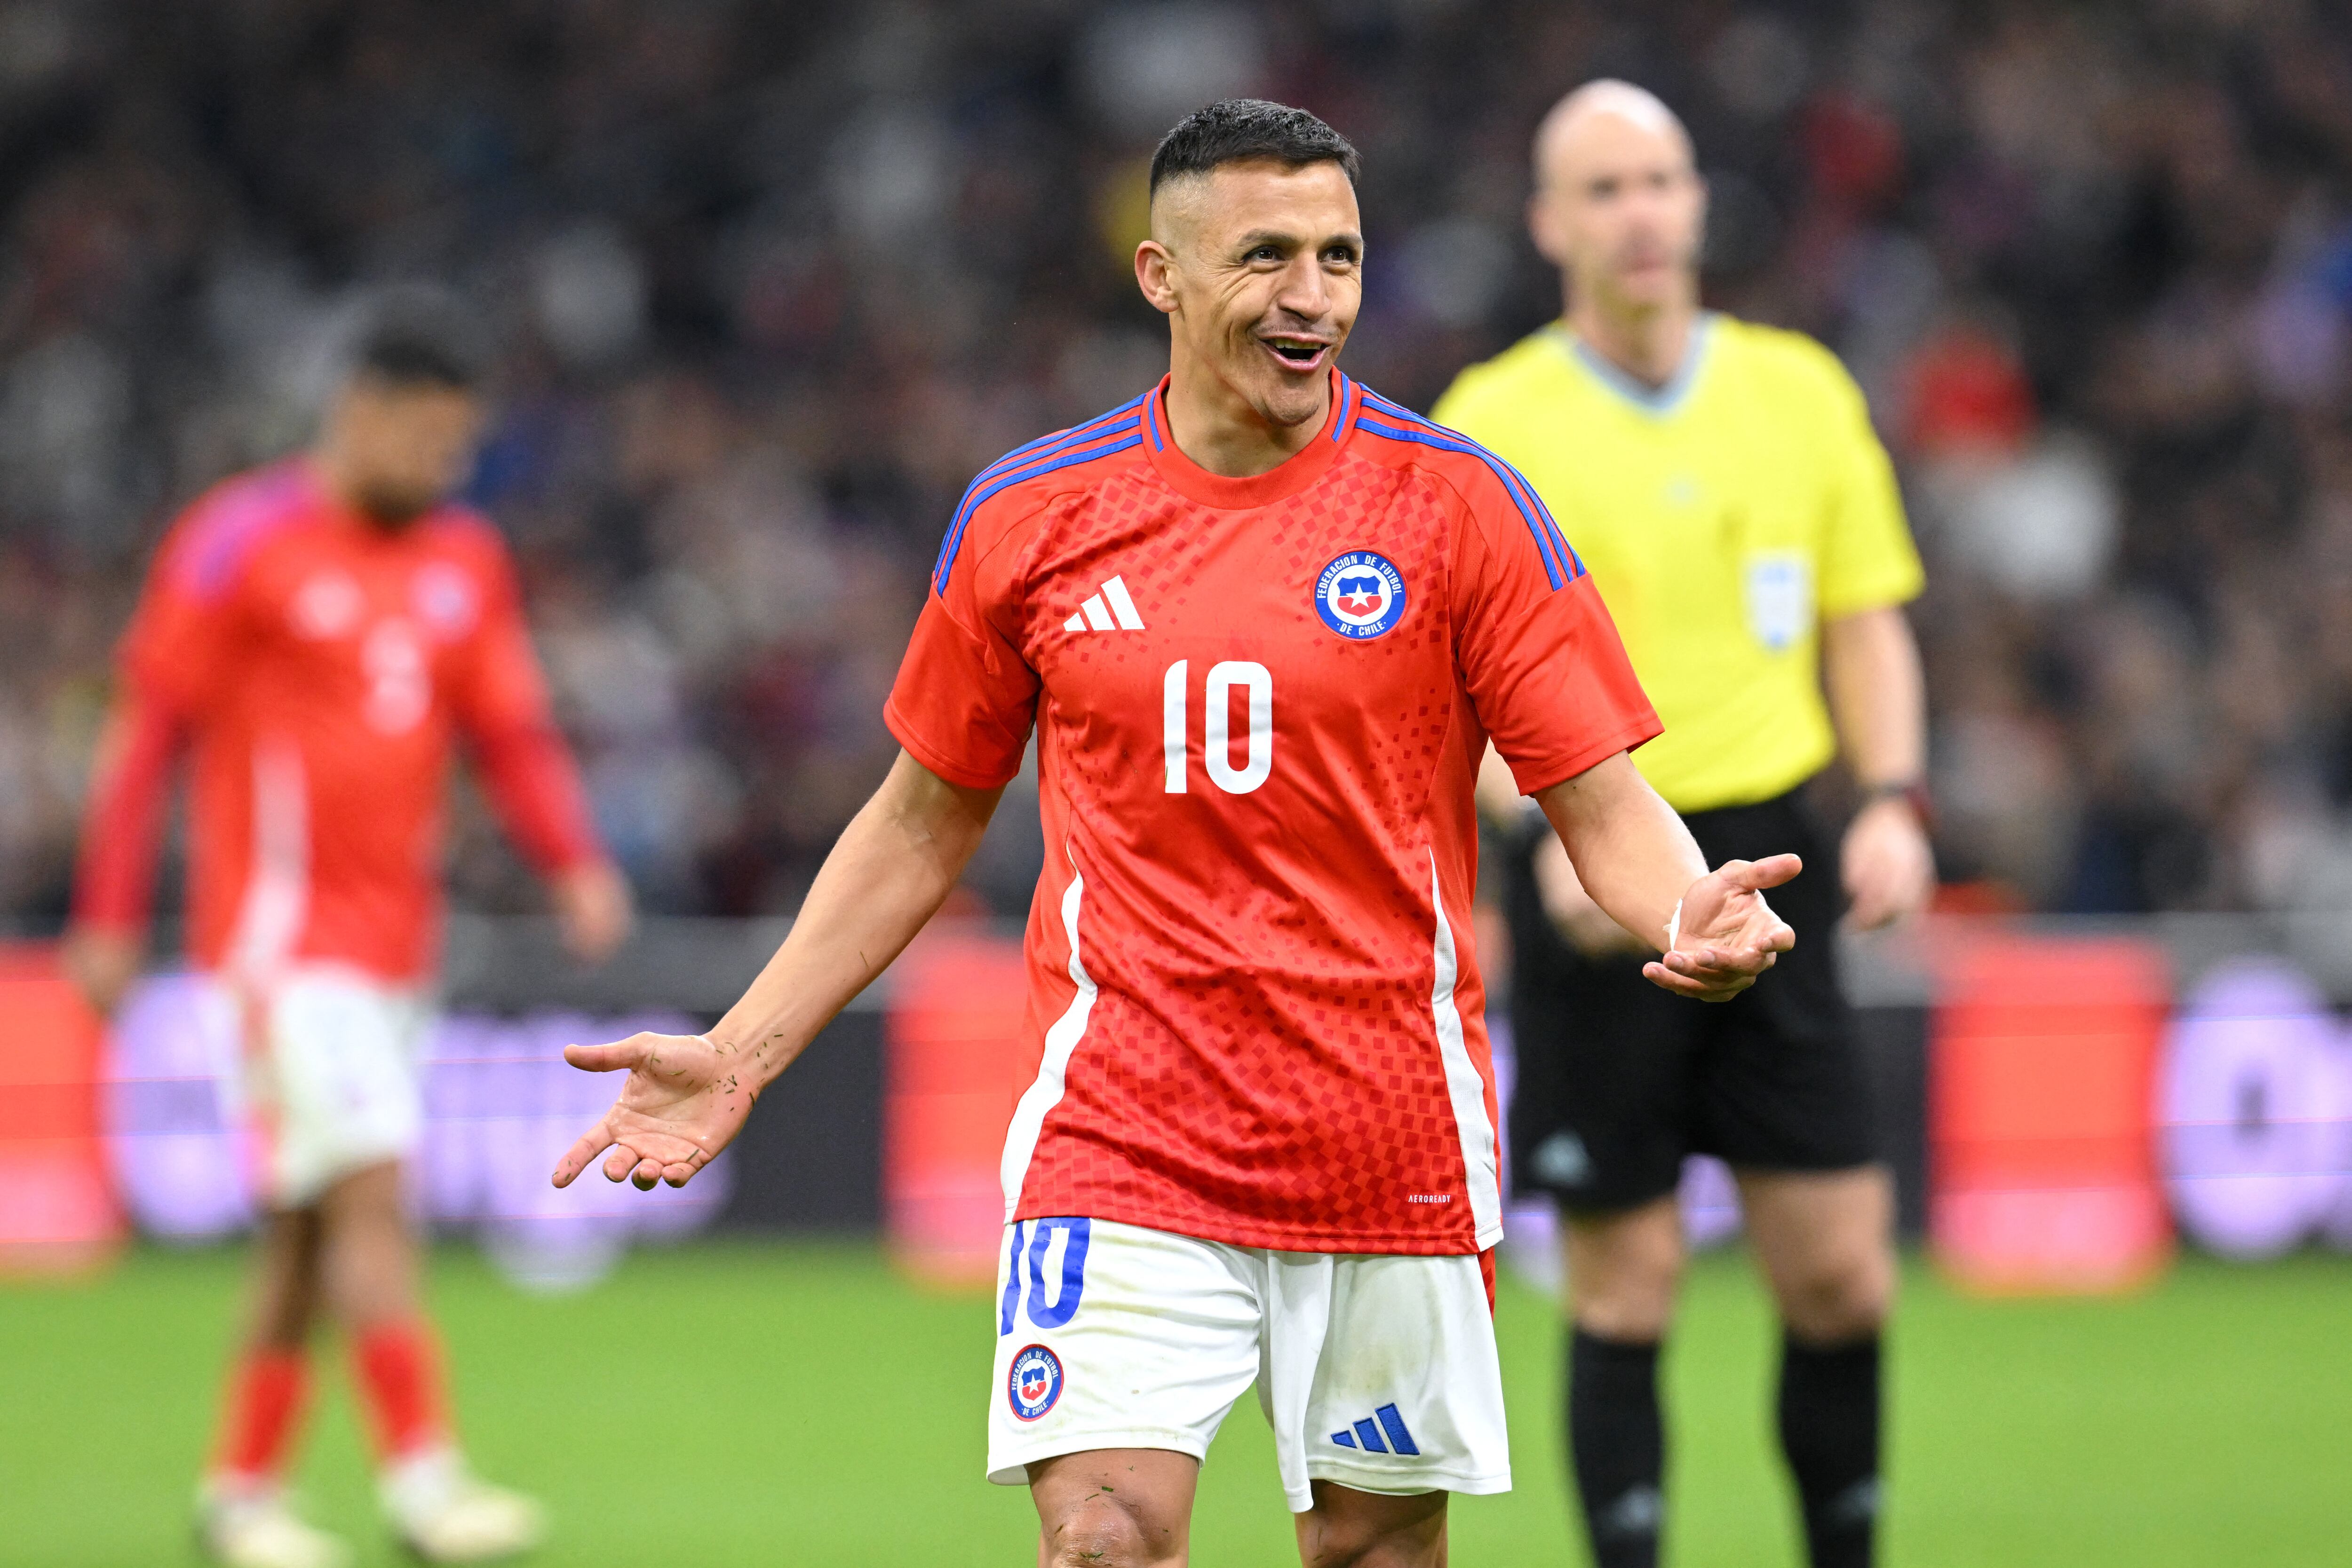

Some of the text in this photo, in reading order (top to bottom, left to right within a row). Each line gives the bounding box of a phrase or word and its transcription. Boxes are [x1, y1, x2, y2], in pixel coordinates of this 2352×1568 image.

[1317, 555, 1402, 599] FEDERACION DE FUTBOL
[1339, 621, 1385, 636] DE CHILE
[1164, 659, 1272, 794] 10
[1408, 1195, 1450, 1203] AEROREADY
[1001, 1217, 1091, 1337] 10
[1012, 1352, 1032, 1390] FEDERACION
[1044, 1355, 1058, 1379] FUTBOL
[1023, 1401, 1048, 1416] DE CHILE
